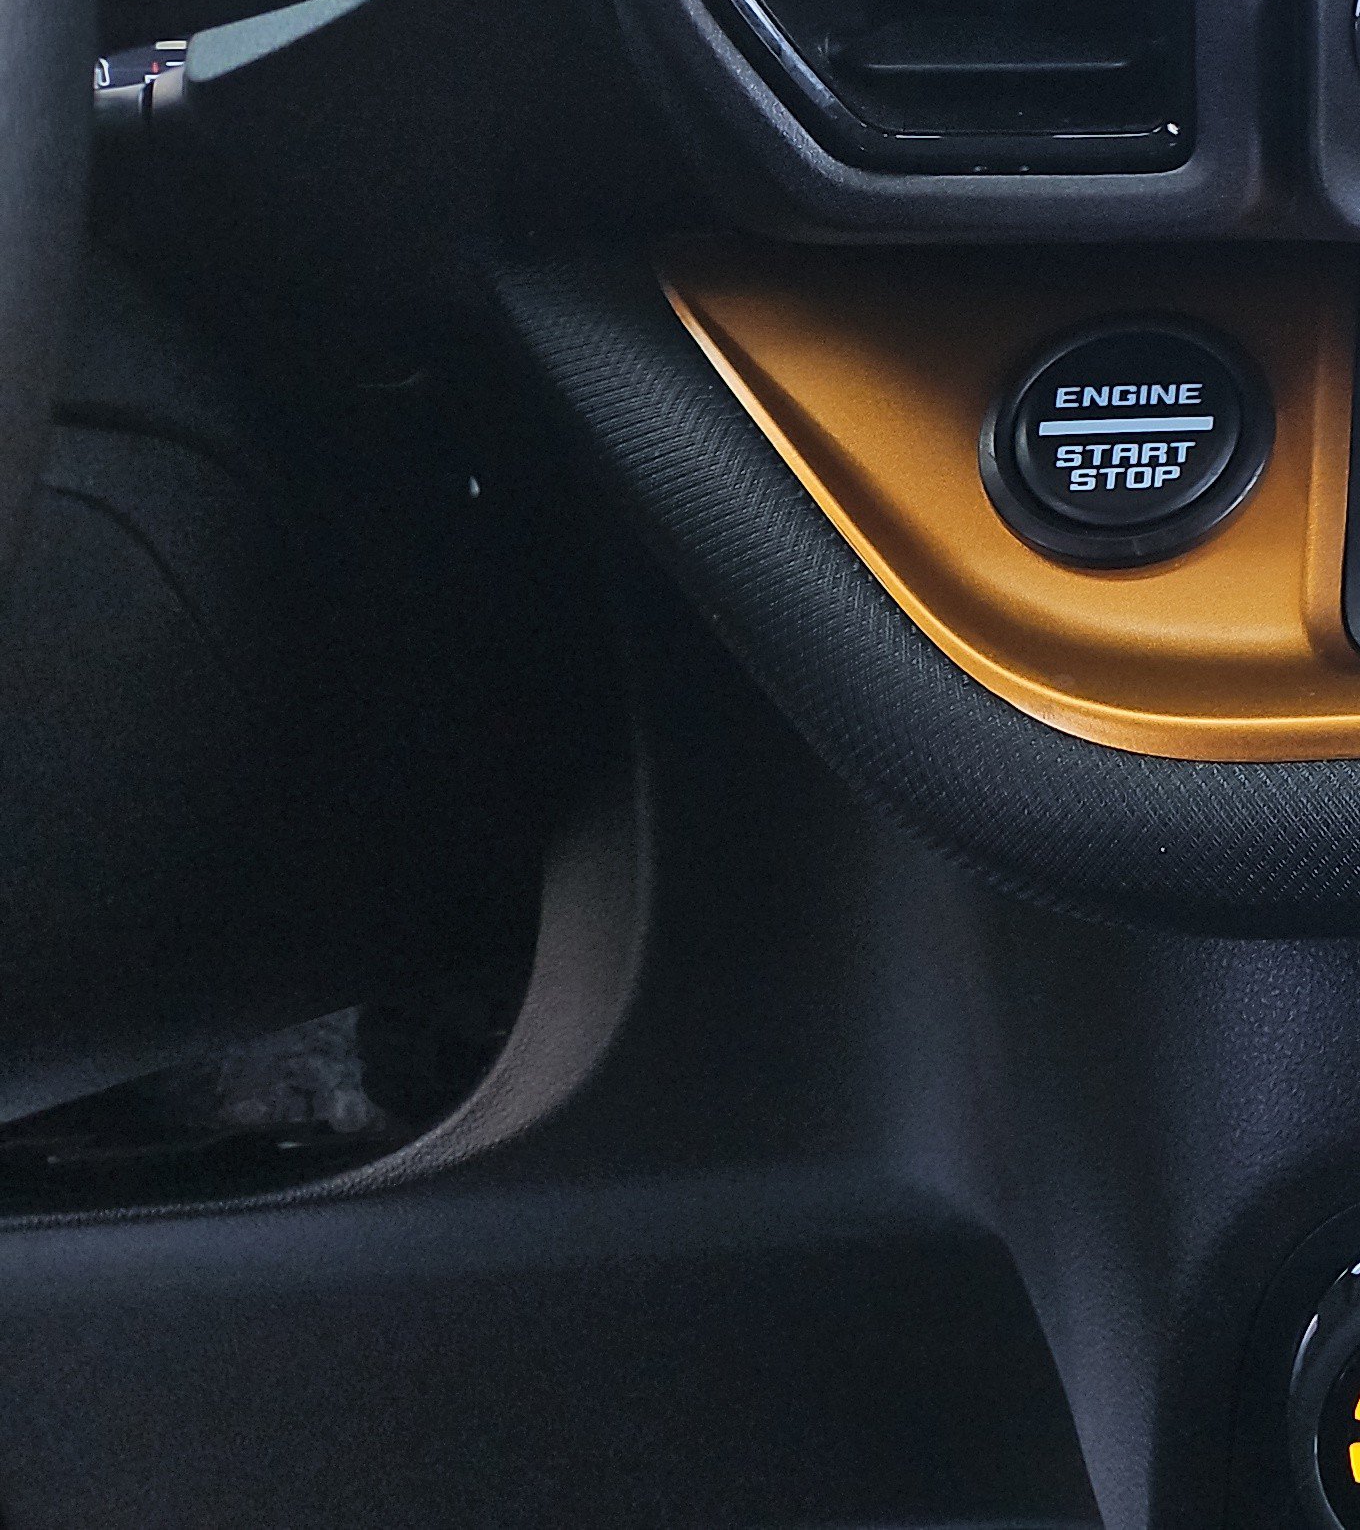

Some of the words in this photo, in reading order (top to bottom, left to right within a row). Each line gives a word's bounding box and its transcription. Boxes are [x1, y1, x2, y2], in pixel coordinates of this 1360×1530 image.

[1055, 383, 1203, 408] ENGINE
[1055, 441, 1196, 468] START
[1069, 466, 1181, 491] STOP
